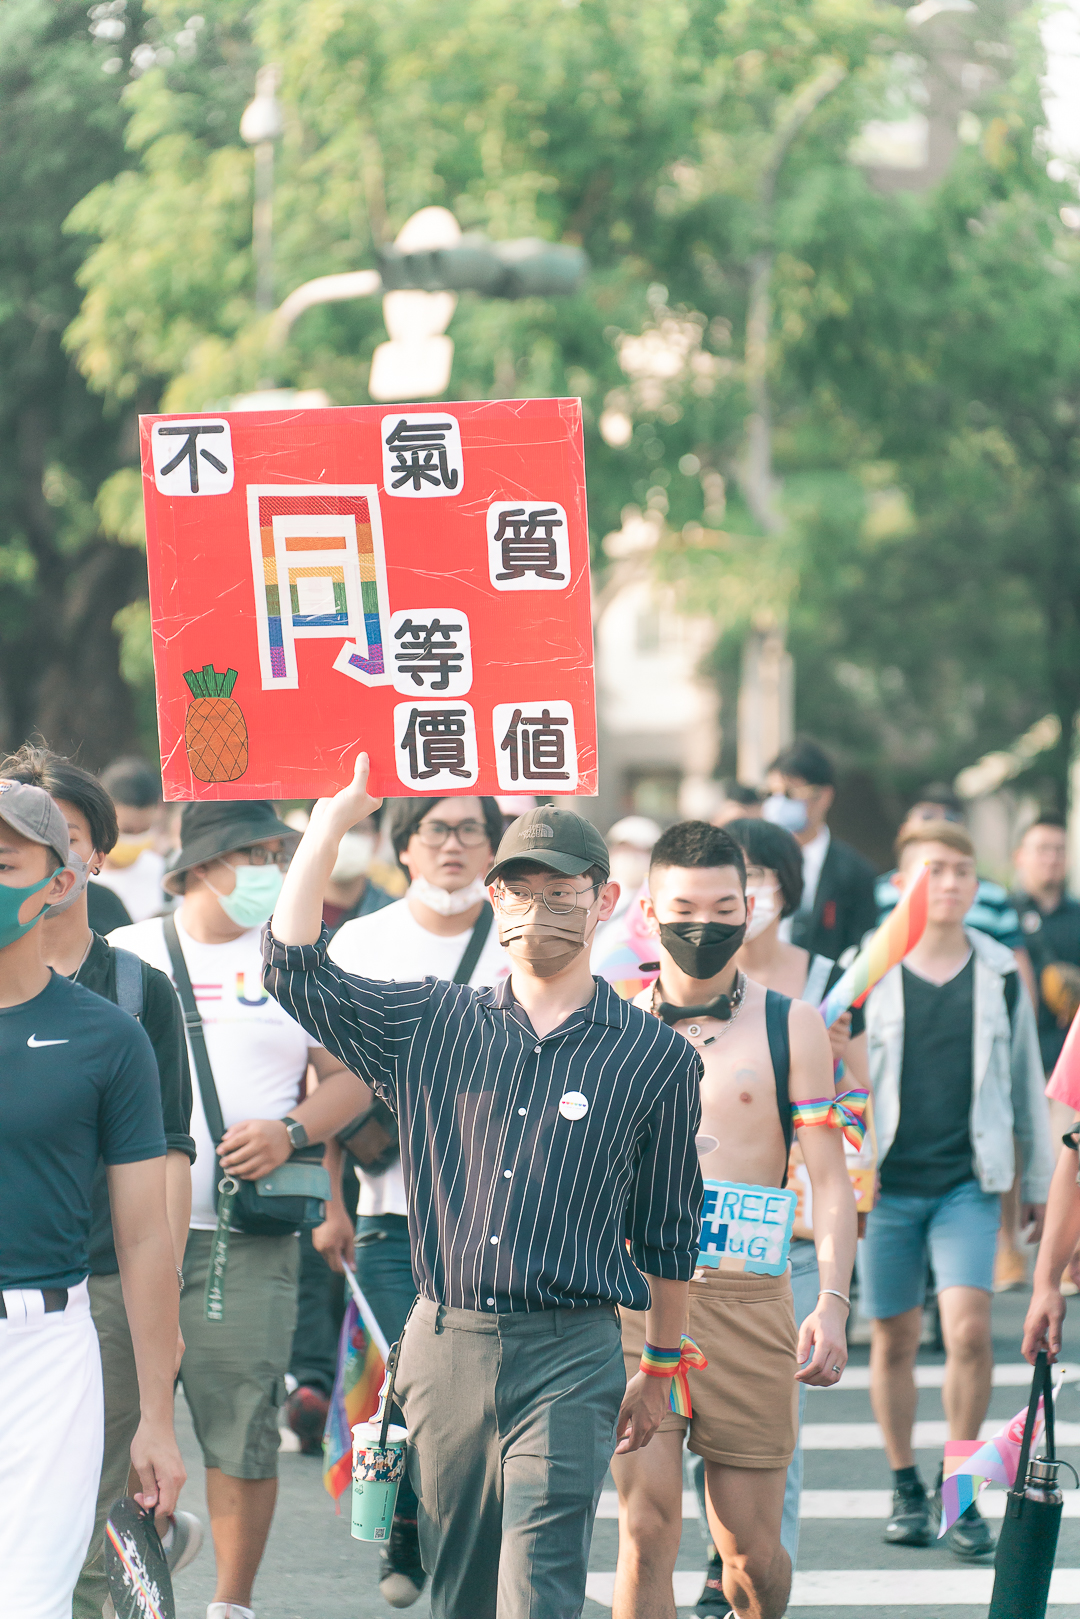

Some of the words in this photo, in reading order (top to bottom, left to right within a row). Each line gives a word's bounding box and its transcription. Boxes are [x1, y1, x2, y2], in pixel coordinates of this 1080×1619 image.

[157, 424, 228, 494] 不
[385, 418, 459, 492] 氣
[493, 507, 566, 582] 質
[247, 485, 391, 688] 同
[393, 617, 465, 691] 等
[701, 1189, 787, 1226] FREE
